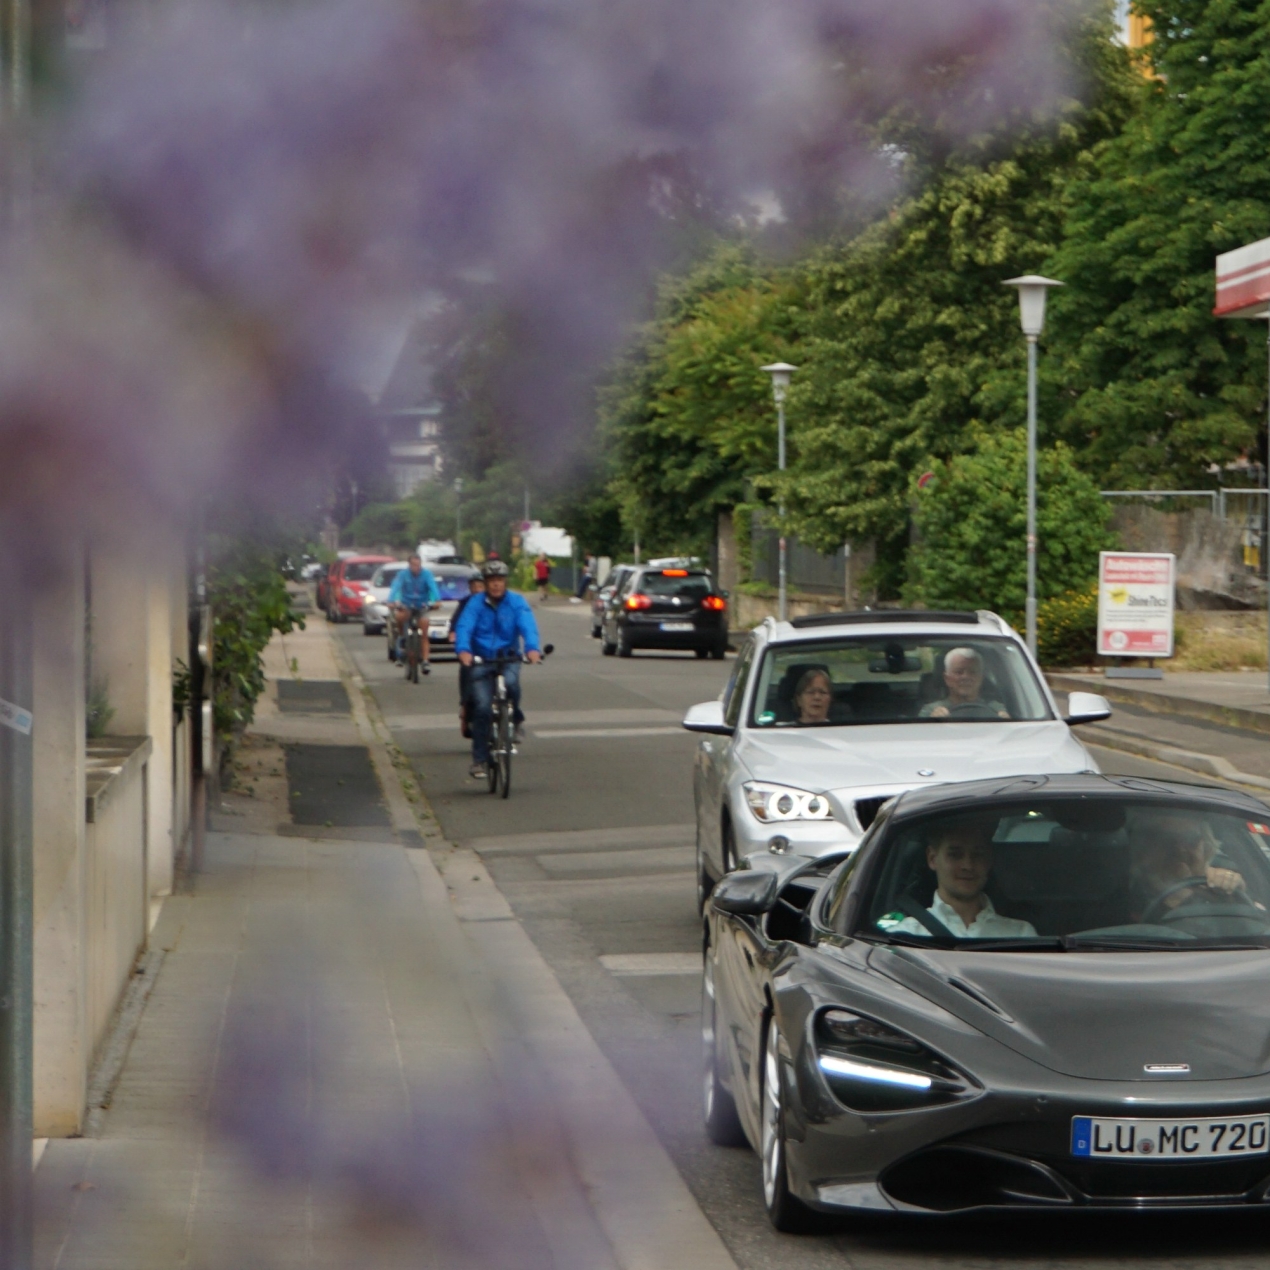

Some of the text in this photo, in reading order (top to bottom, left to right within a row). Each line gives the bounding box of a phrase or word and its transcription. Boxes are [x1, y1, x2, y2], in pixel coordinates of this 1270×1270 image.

[1094, 1121, 1266, 1153] LU MC 720
